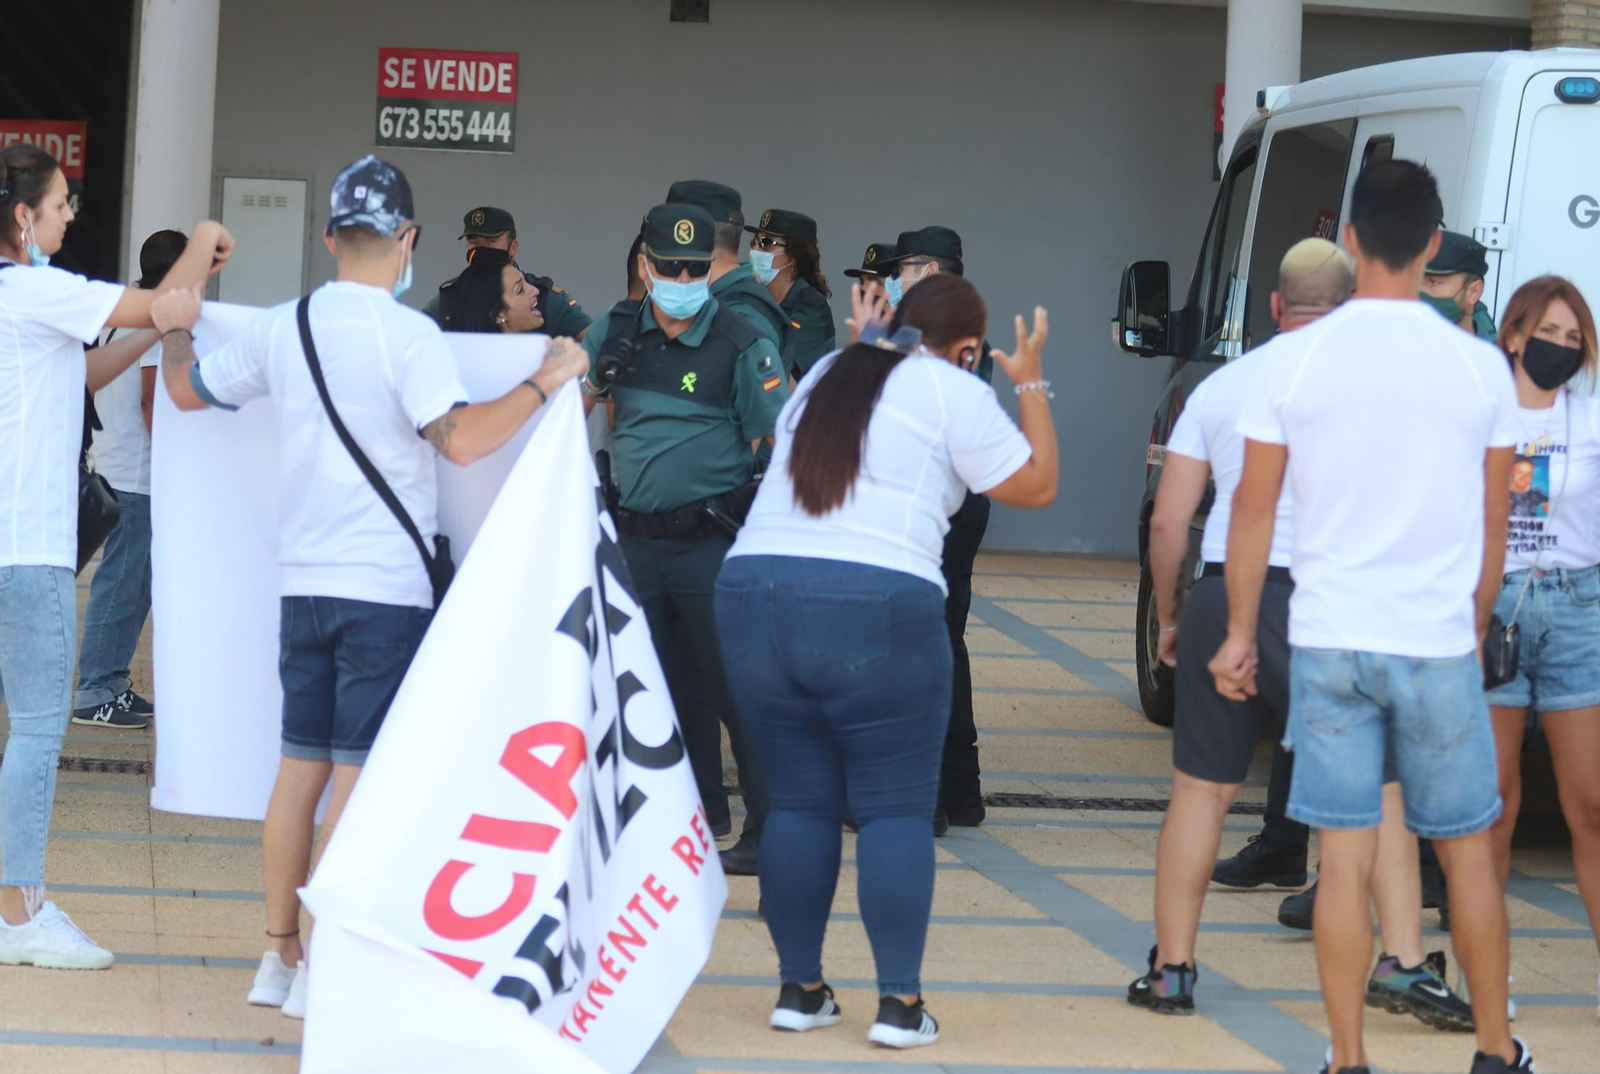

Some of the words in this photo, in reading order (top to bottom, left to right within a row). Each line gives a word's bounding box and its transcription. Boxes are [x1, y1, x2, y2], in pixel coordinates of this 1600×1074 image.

[383, 57, 416, 88] SE
[423, 59, 513, 93] VENDE
[379, 106, 419, 139] 673
[423, 109, 463, 142] 555
[466, 111, 511, 144] 444
[1568, 194, 1600, 229] G
